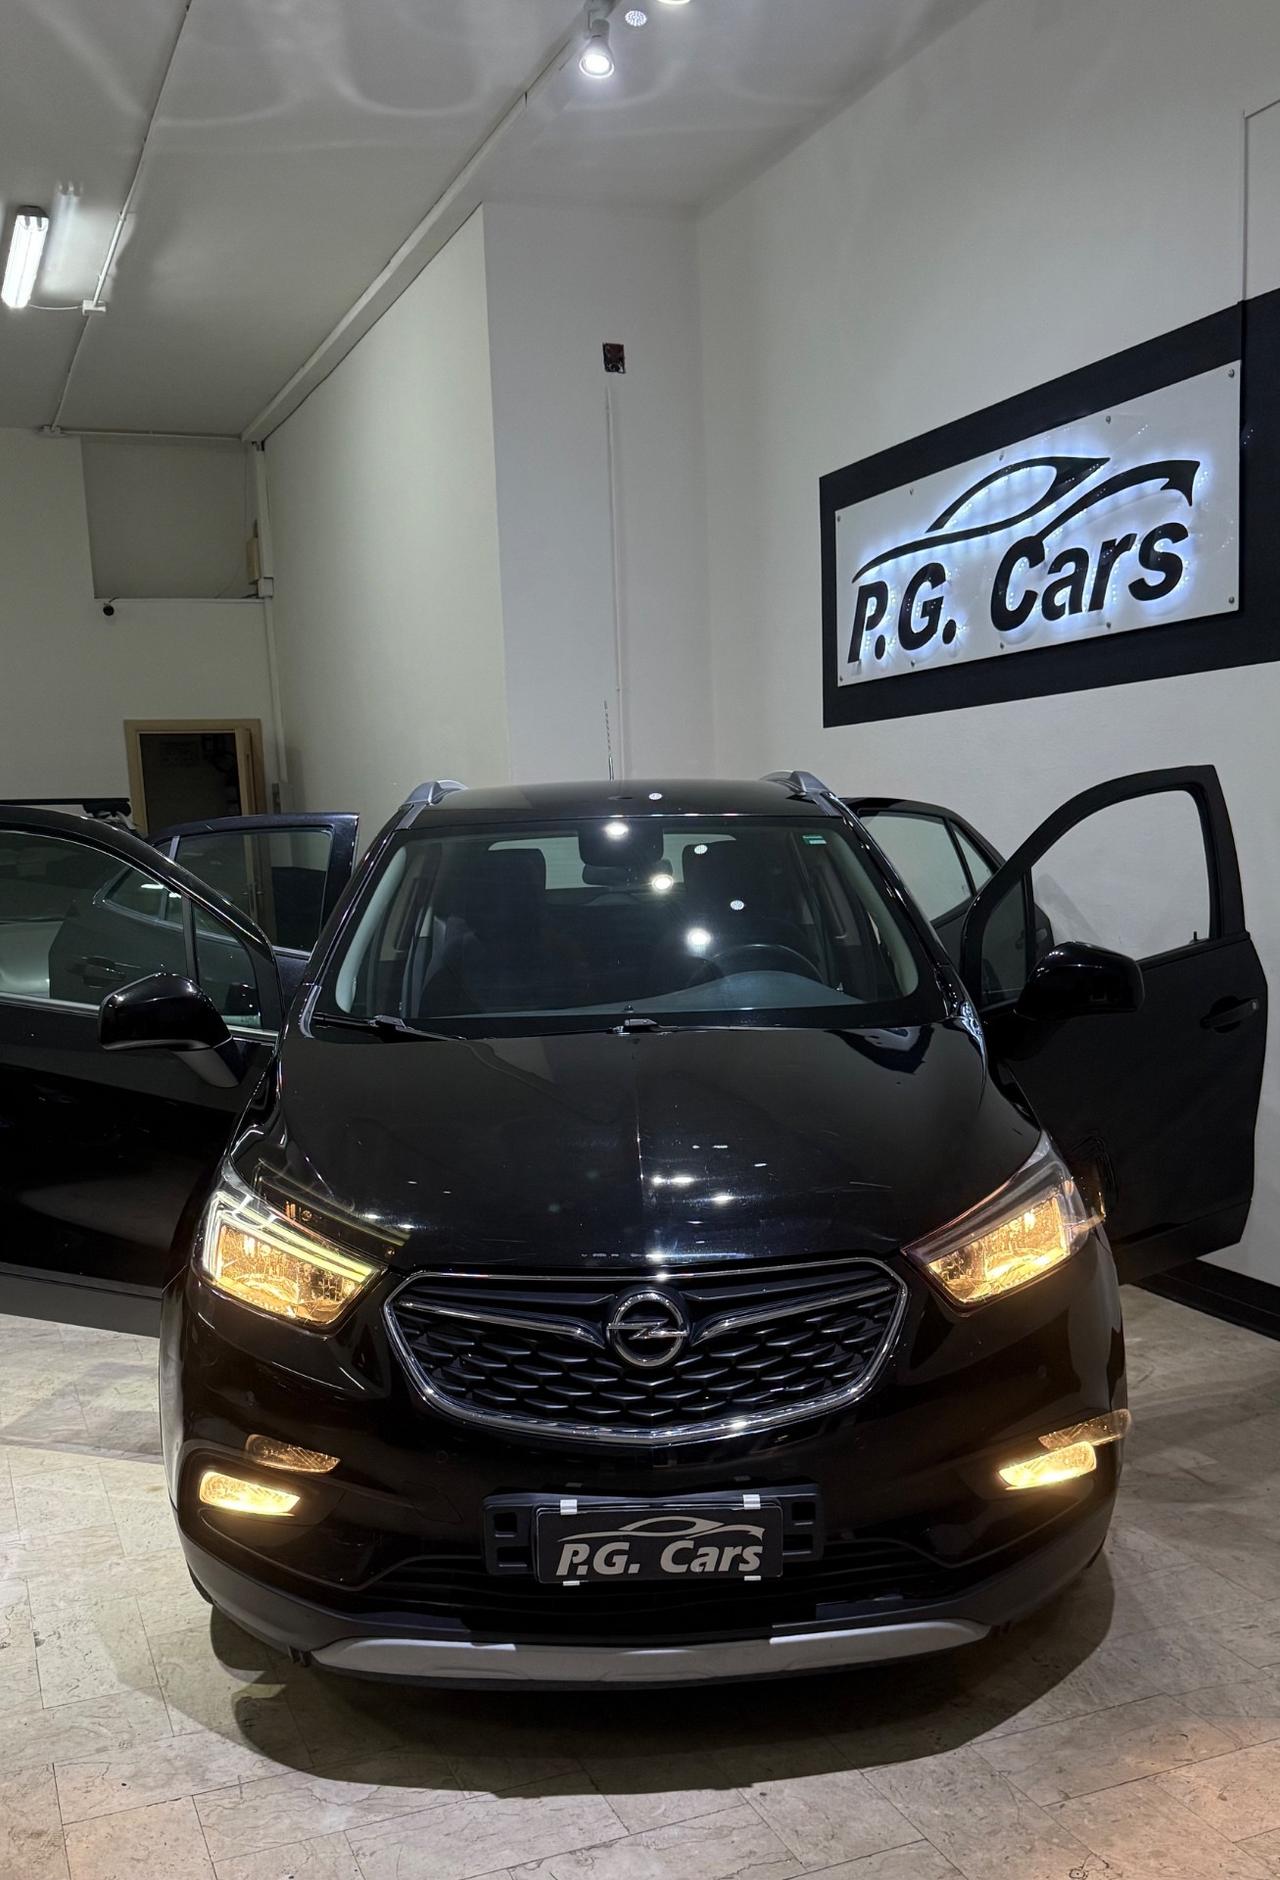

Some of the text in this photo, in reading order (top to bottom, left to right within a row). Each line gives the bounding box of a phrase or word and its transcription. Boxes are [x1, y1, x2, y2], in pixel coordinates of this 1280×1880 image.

[847, 522, 1188, 663] P.G. Cars
[557, 1540, 763, 1575] P.G. Cars
